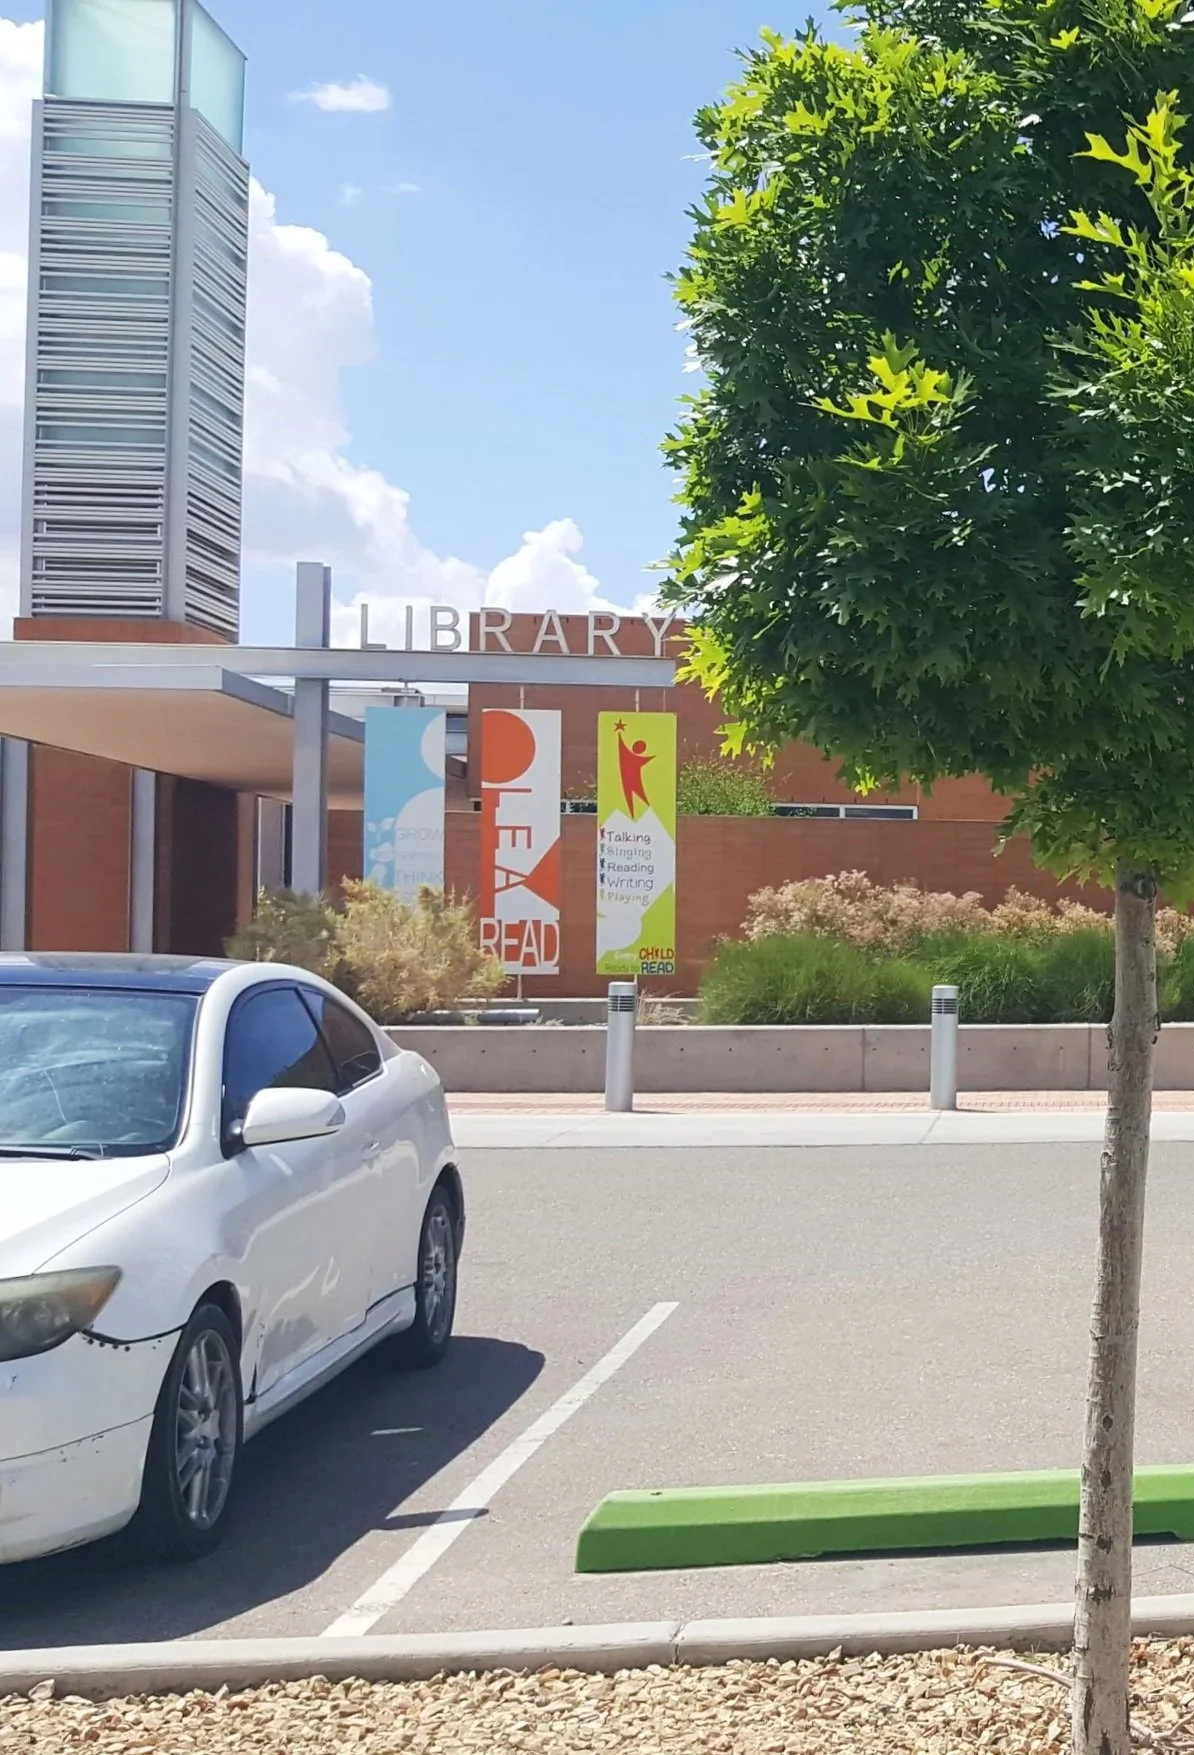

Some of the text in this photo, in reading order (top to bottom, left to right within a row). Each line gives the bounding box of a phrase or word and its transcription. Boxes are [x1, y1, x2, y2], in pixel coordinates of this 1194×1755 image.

[361, 603, 677, 658] LIBRARY
[607, 831, 651, 845] Talking
[607, 846, 652, 860] Singing
[607, 862, 655, 875] Reading
[607, 876, 654, 891] Writing
[607, 891, 650, 906] Playing
[480, 917, 560, 967] READ
[639, 947, 675, 960] CHILD
[641, 961, 674, 974] READ
